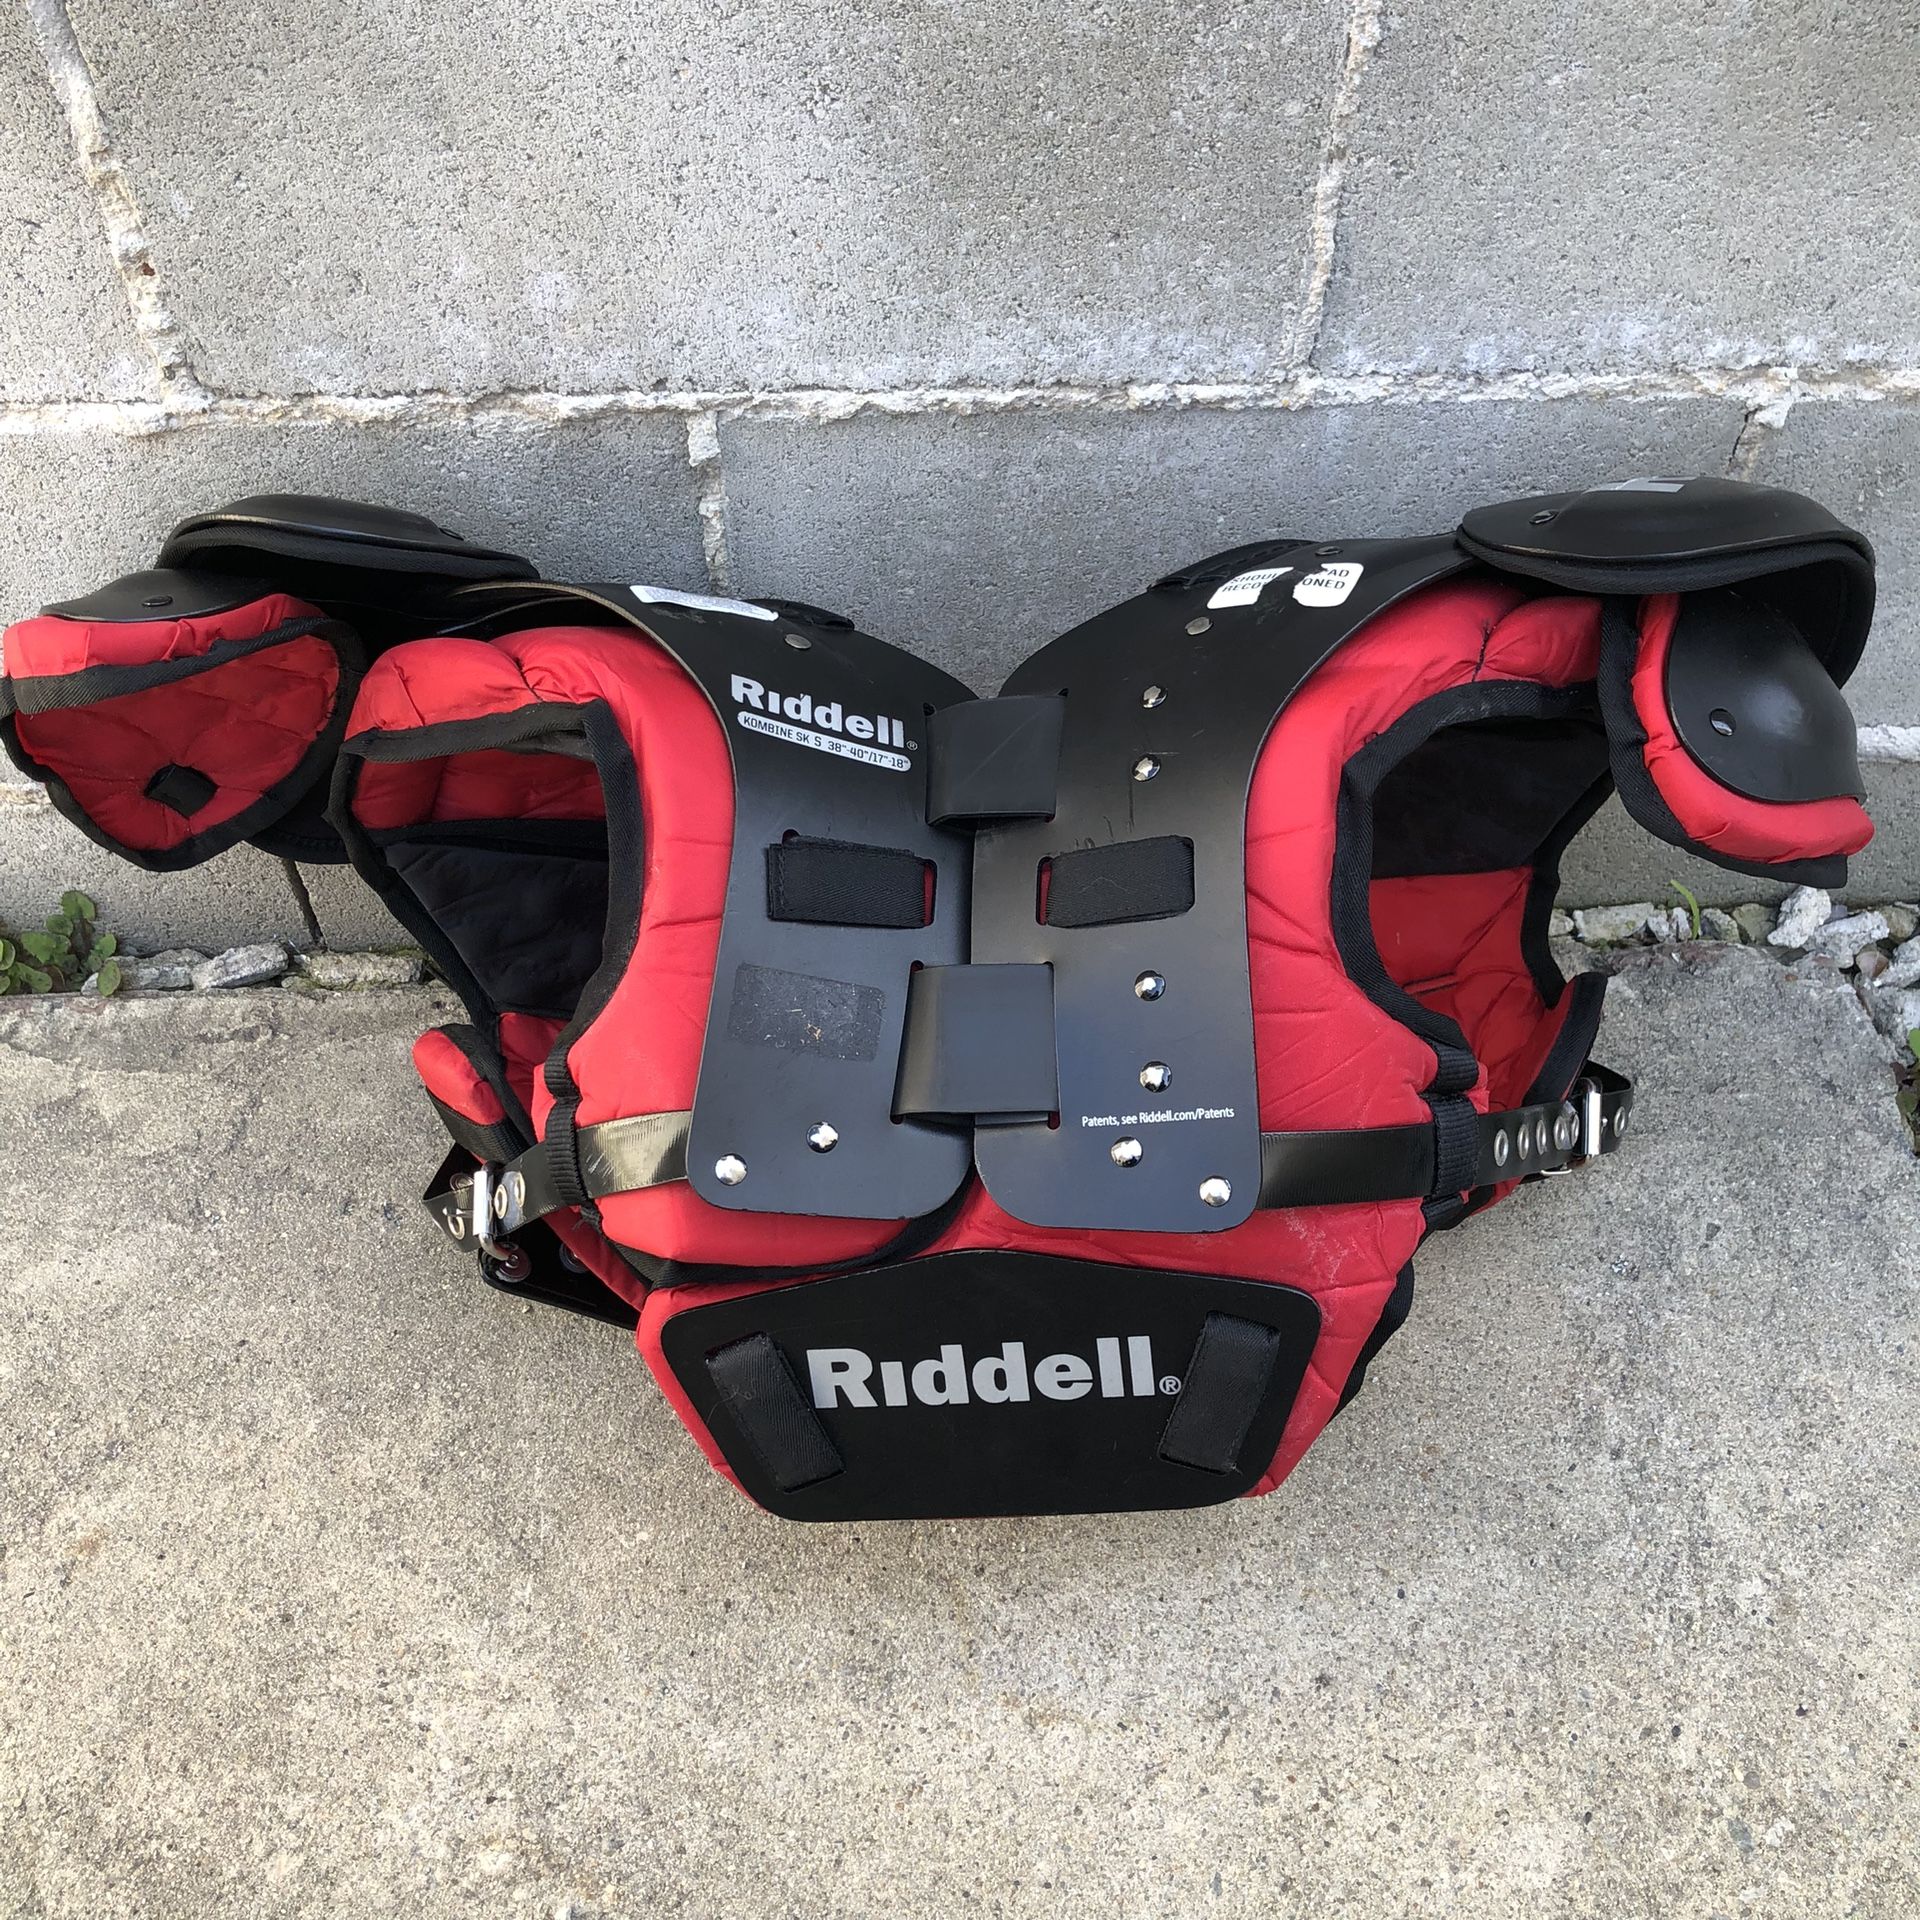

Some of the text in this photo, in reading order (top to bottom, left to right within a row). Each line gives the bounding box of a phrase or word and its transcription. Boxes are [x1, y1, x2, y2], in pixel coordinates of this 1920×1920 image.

[743, 715, 794, 740] KOMBINE
[796, 731, 810, 744] SK
[814, 735, 822, 747] S
[1081, 1107, 1235, 1127] Patents, see Riddell.com/Patents
